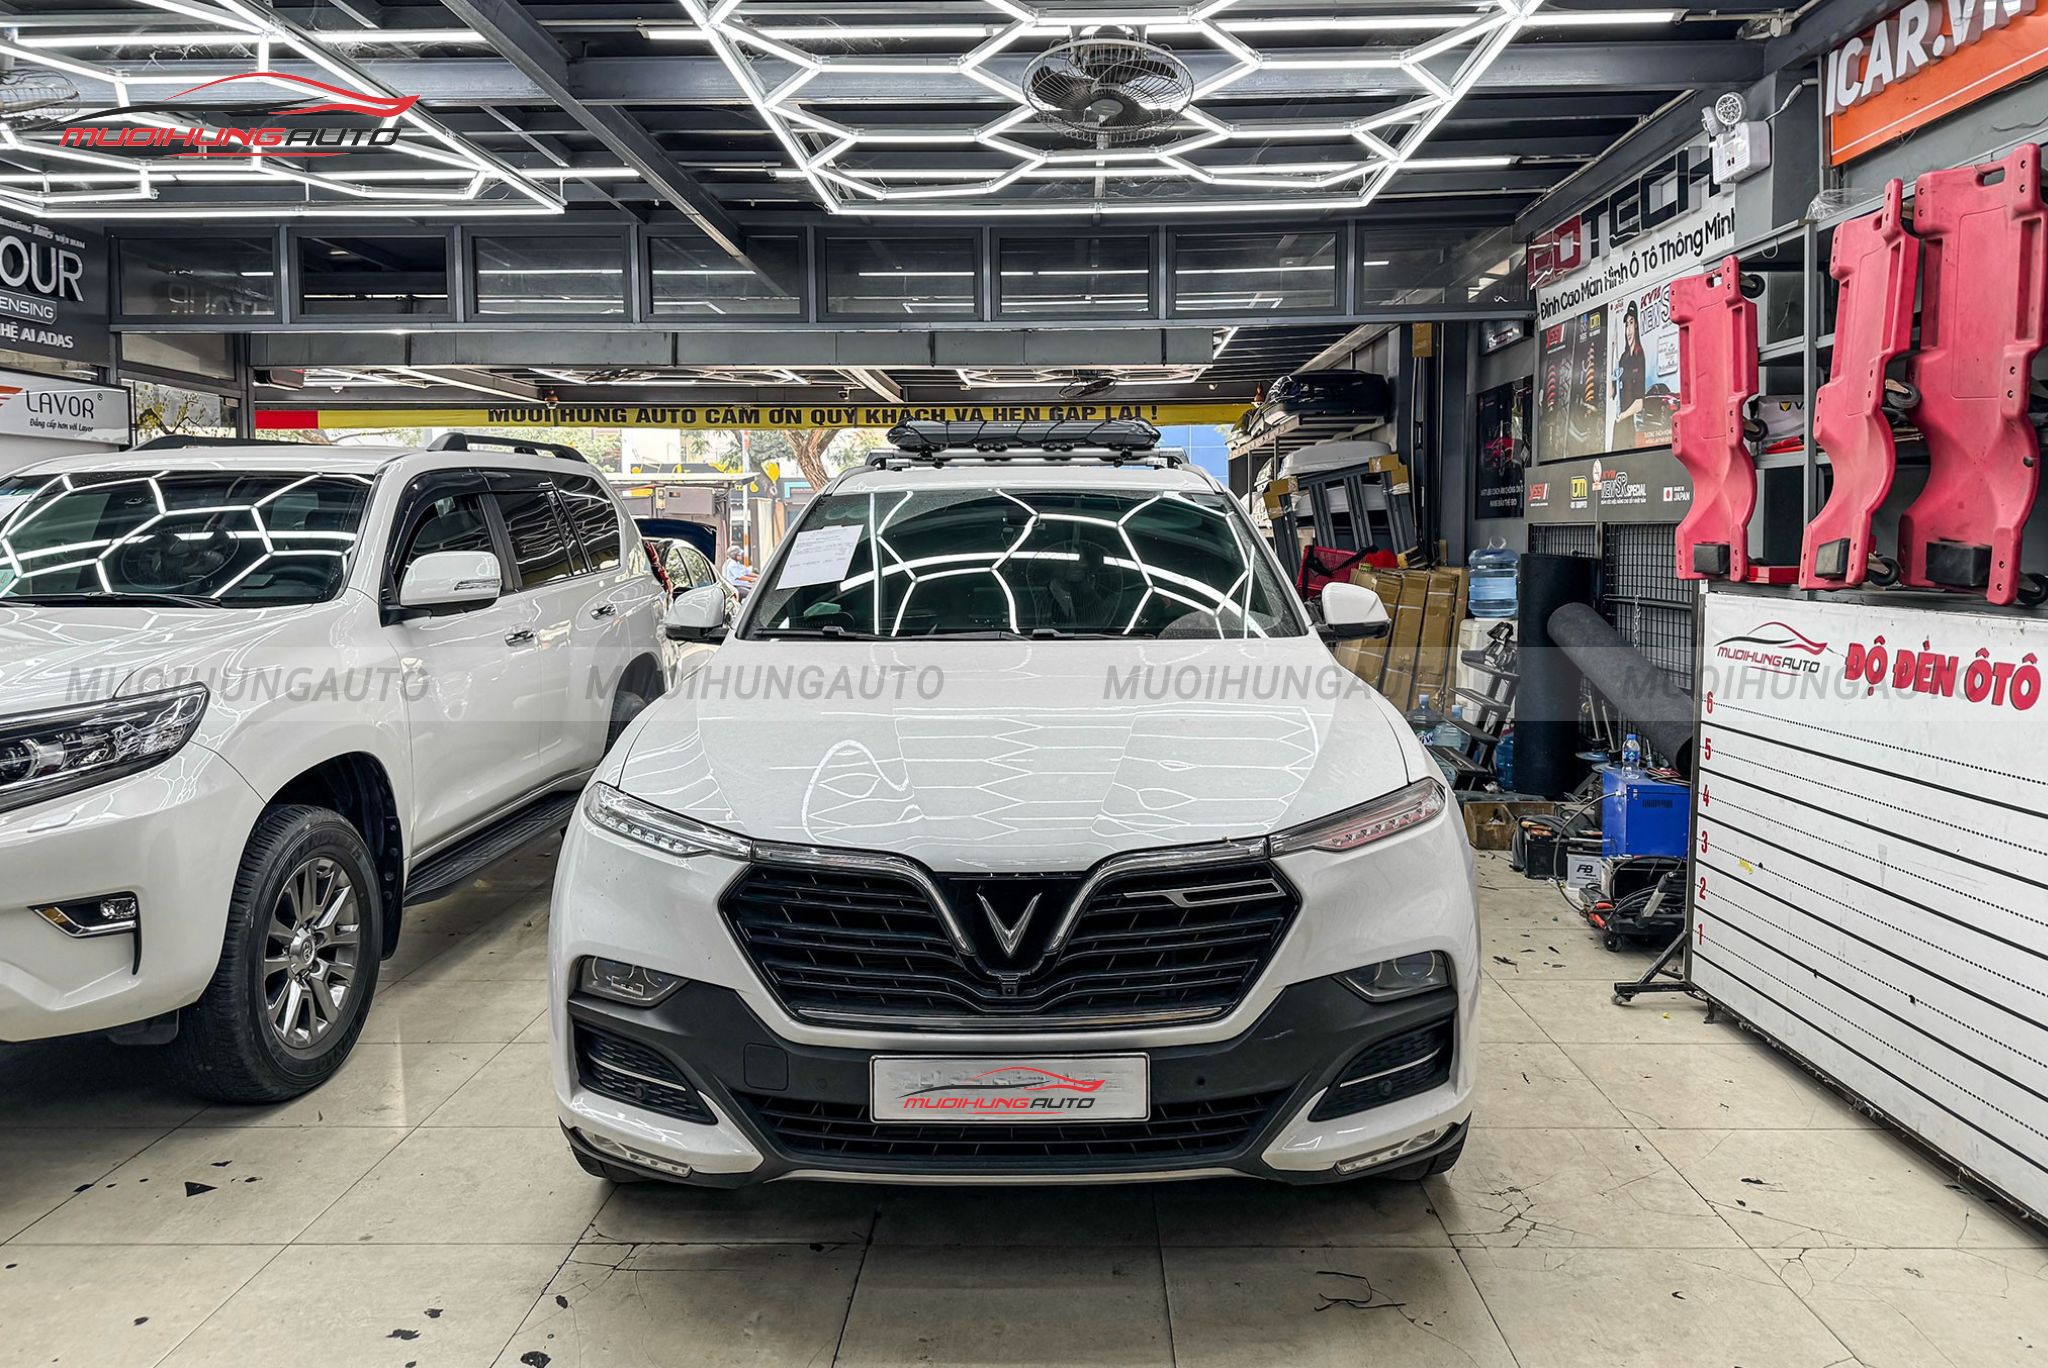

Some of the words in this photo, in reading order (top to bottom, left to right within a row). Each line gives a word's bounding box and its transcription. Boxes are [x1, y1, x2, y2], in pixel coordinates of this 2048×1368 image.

[1560, 288, 1580, 311] Cao
[1581, 276, 1603, 302] Màn
[1629, 250, 1640, 279] Ô
[1642, 245, 1659, 273] Tô
[1659, 228, 1704, 264] Thông
[37, 330, 74, 349] ADAS
[26, 390, 94, 419] LAVOR
[635, 408, 697, 424] AUTO
[768, 407, 802, 425] ƠN
[1844, 635, 1889, 696] ĐỘ
[1892, 639, 1959, 697] ĐÈN
[1964, 647, 2042, 711] ÔTÔ
[1706, 691, 1714, 714] 6
[1704, 738, 1712, 761] 5
[1702, 785, 1710, 807] 4
[1701, 831, 1709, 854] 3
[1699, 876, 1707, 901] 2
[1697, 923, 1704, 945] 1
